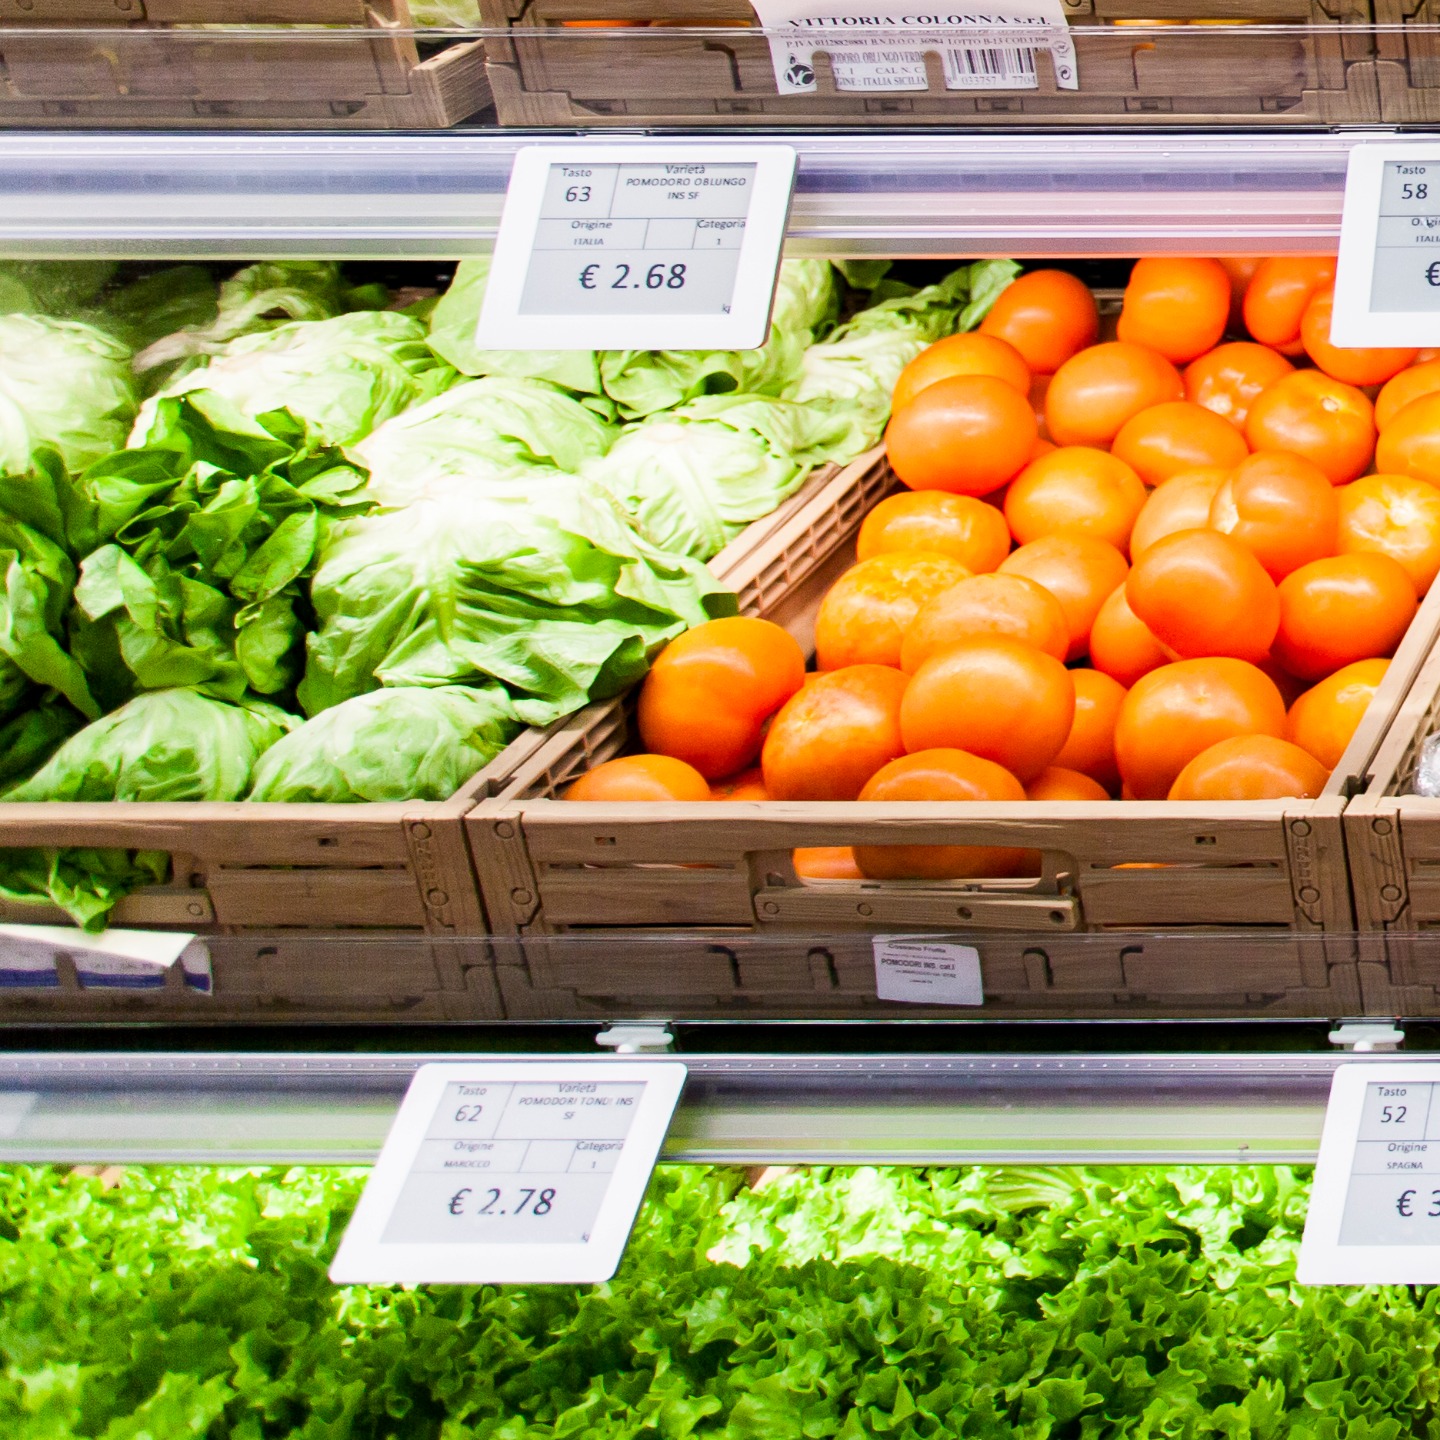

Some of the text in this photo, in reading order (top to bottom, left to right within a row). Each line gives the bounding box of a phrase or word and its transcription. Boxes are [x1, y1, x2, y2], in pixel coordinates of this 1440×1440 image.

[788, 14, 1052, 28] VITTORIA COLONNA s.r.l.
[862, 76, 894, 86] ITALIA
[562, 168, 592, 178] Tasto
[665, 164, 706, 175] Varietà
[1396, 164, 1426, 174] Tasto
[626, 178, 746, 186] POMODORO OBLUNGO
[564, 186, 592, 202] 63
[667, 192, 700, 200] INS SF
[1401, 182, 1428, 200] 58
[570, 218, 746, 231] Origine Categoria
[573, 238, 604, 246] ITALIA
[578, 264, 687, 289] € 2.68
[458, 1086, 488, 1096] Tasto
[1378, 1086, 1407, 1096] Tasto
[518, 1097, 577, 1106] POMODORI
[616, 1097, 633, 1106] INS
[454, 1104, 483, 1122] 62
[1380, 1106, 1407, 1124] 52
[1388, 1142, 1428, 1153] Origine
[444, 1160, 490, 1168] MAROCCO
[1386, 1161, 1424, 1170] SPAGNA
[448, 1188, 556, 1216] € 2.78
[1396, 1189, 1417, 1217] €
